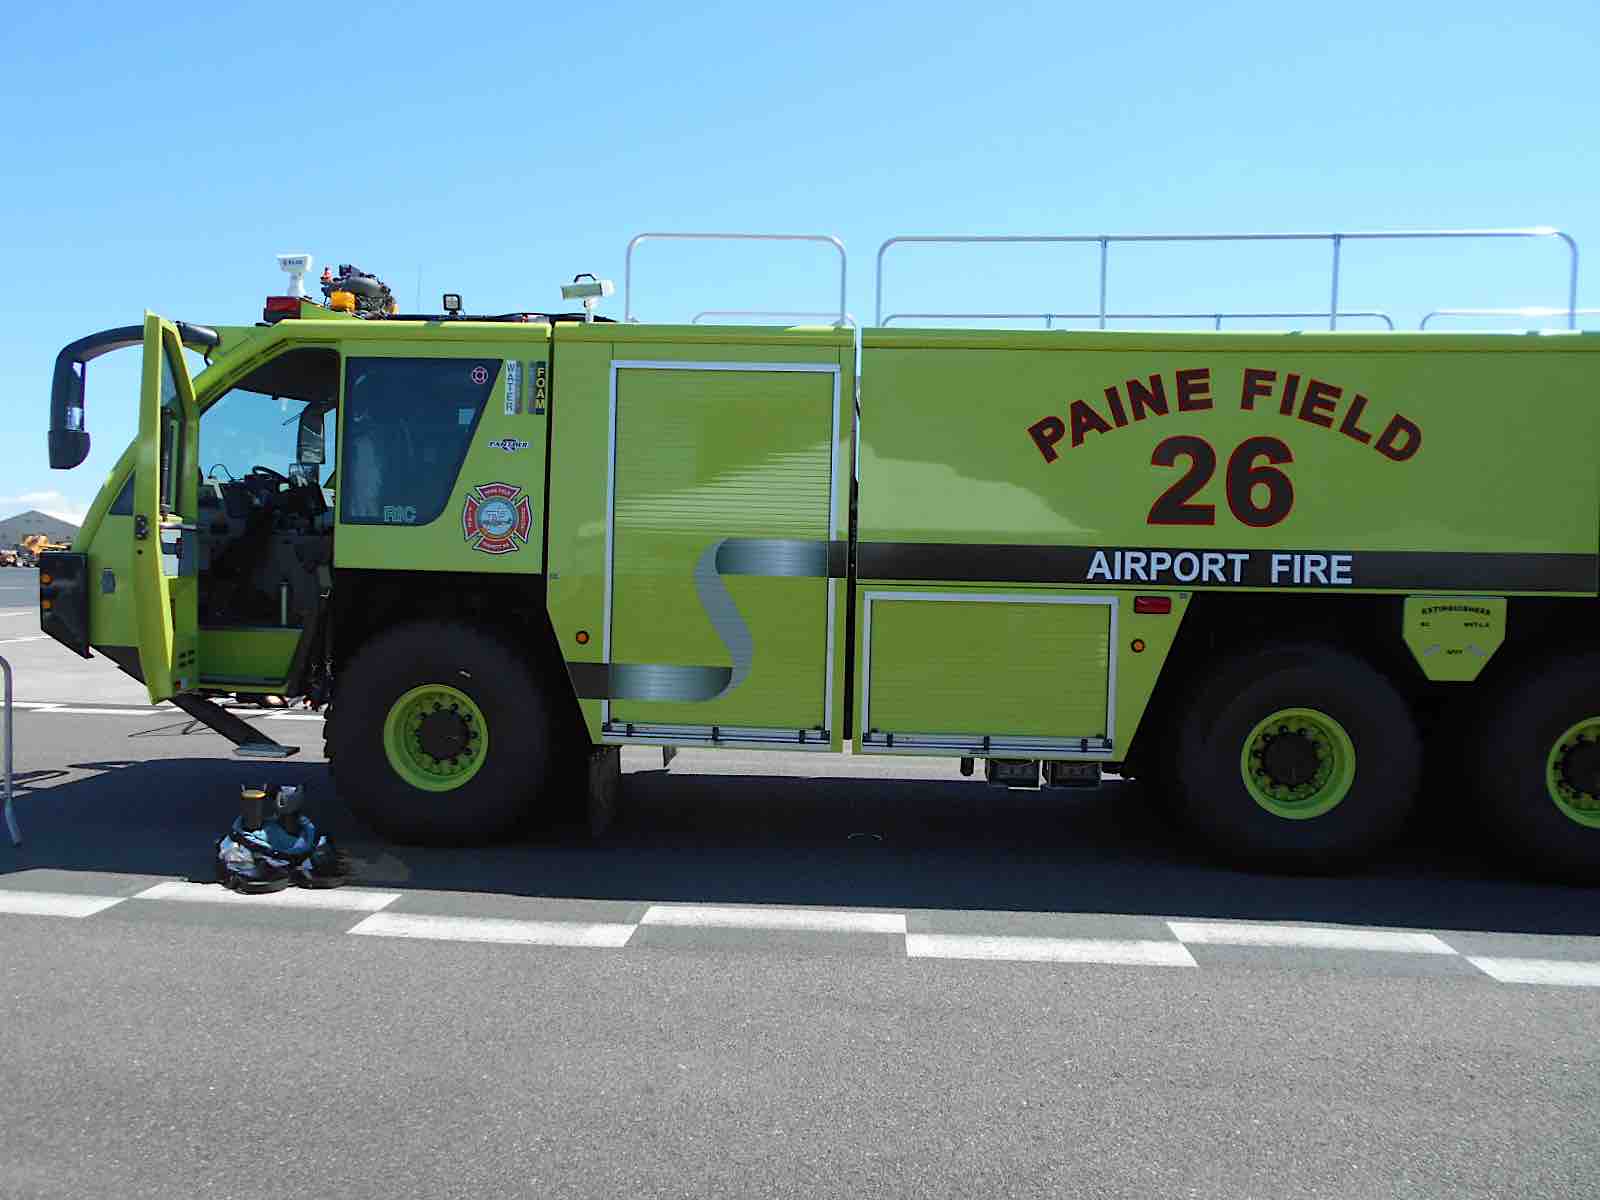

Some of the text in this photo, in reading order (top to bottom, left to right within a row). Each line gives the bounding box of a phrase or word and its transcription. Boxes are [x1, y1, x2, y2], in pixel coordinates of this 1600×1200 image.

[505, 360, 516, 411] WATER
[535, 367, 545, 409] FOAM
[1027, 368, 1422, 464] PAINE FIELD
[1146, 434, 1295, 528] 26
[1086, 550, 1354, 586] AIRPORT FIRE
